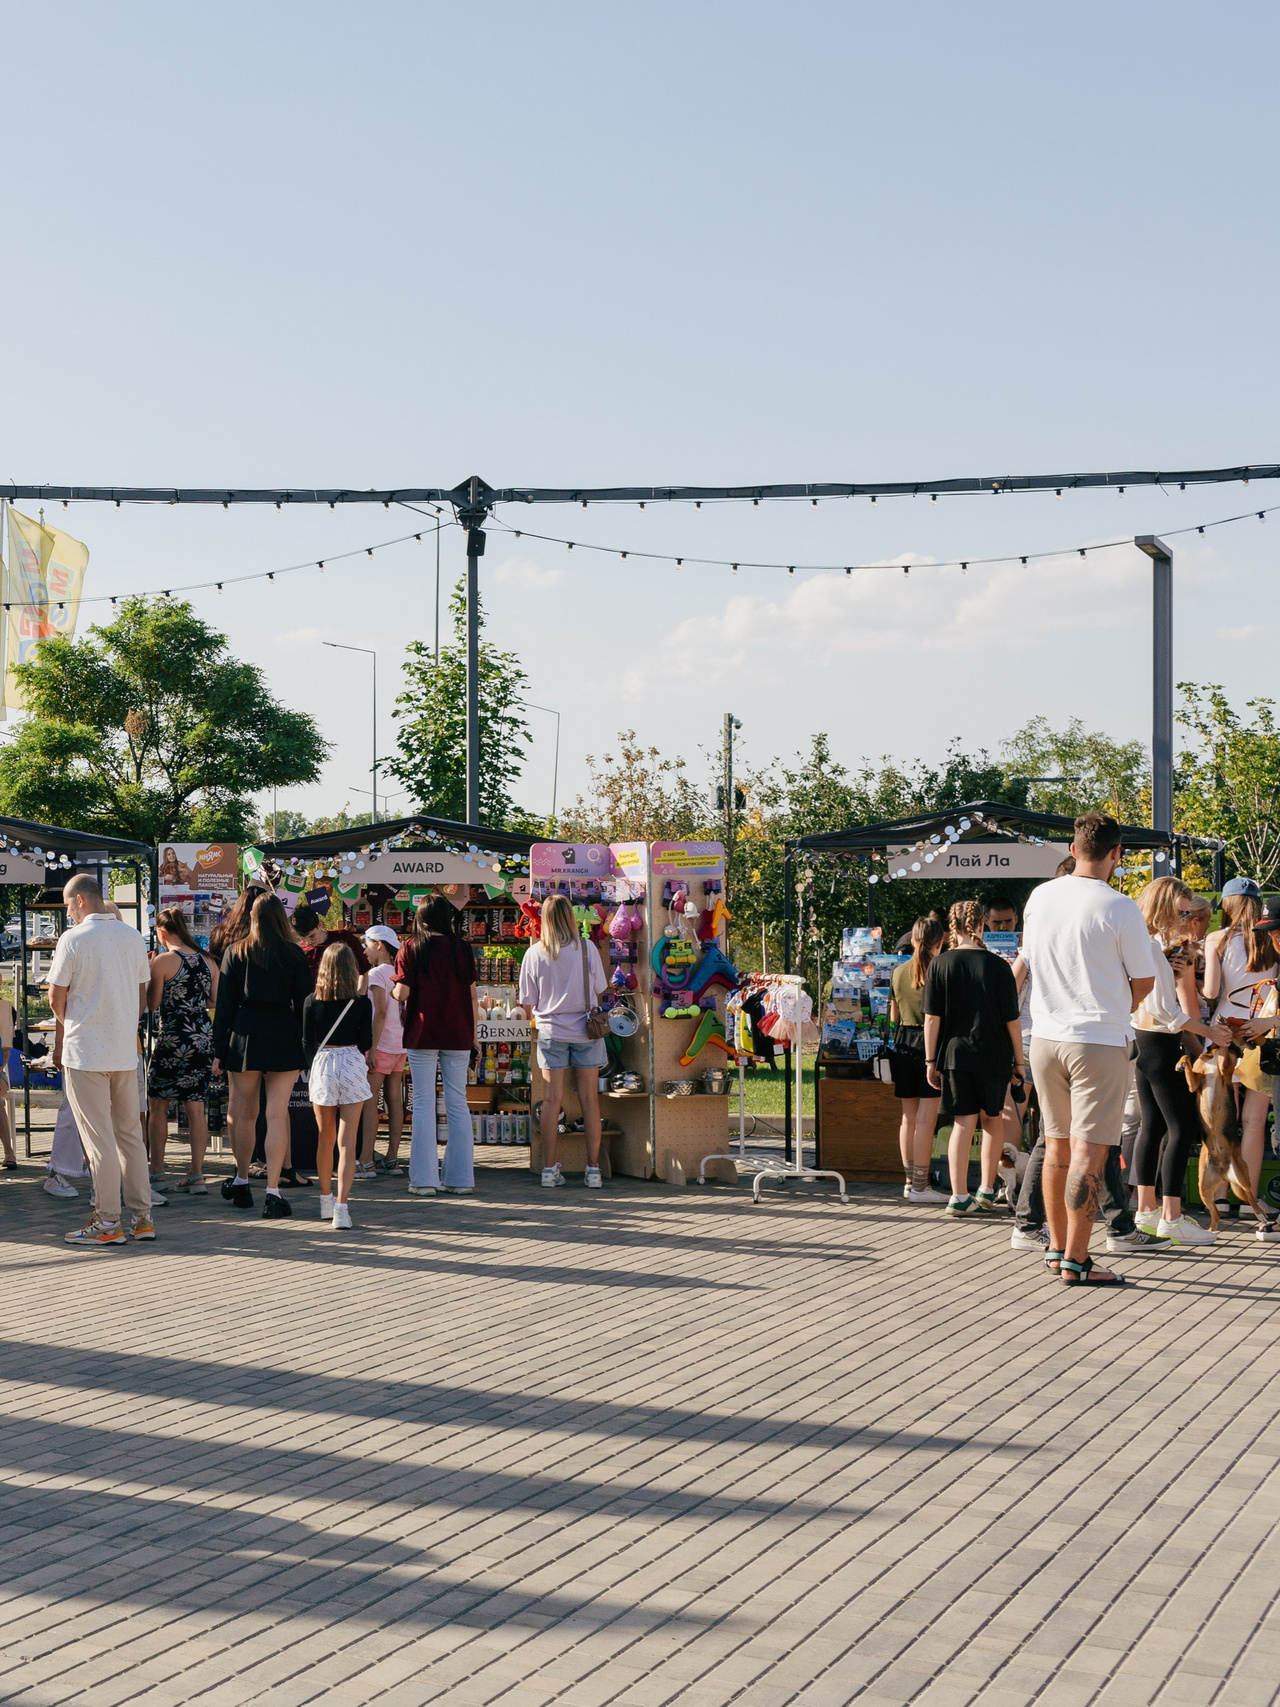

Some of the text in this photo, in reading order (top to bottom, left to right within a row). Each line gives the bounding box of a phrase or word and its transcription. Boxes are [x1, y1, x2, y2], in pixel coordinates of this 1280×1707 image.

[946, 855, 1010, 867] Лай Ла
[392, 862, 444, 873] AWARD
